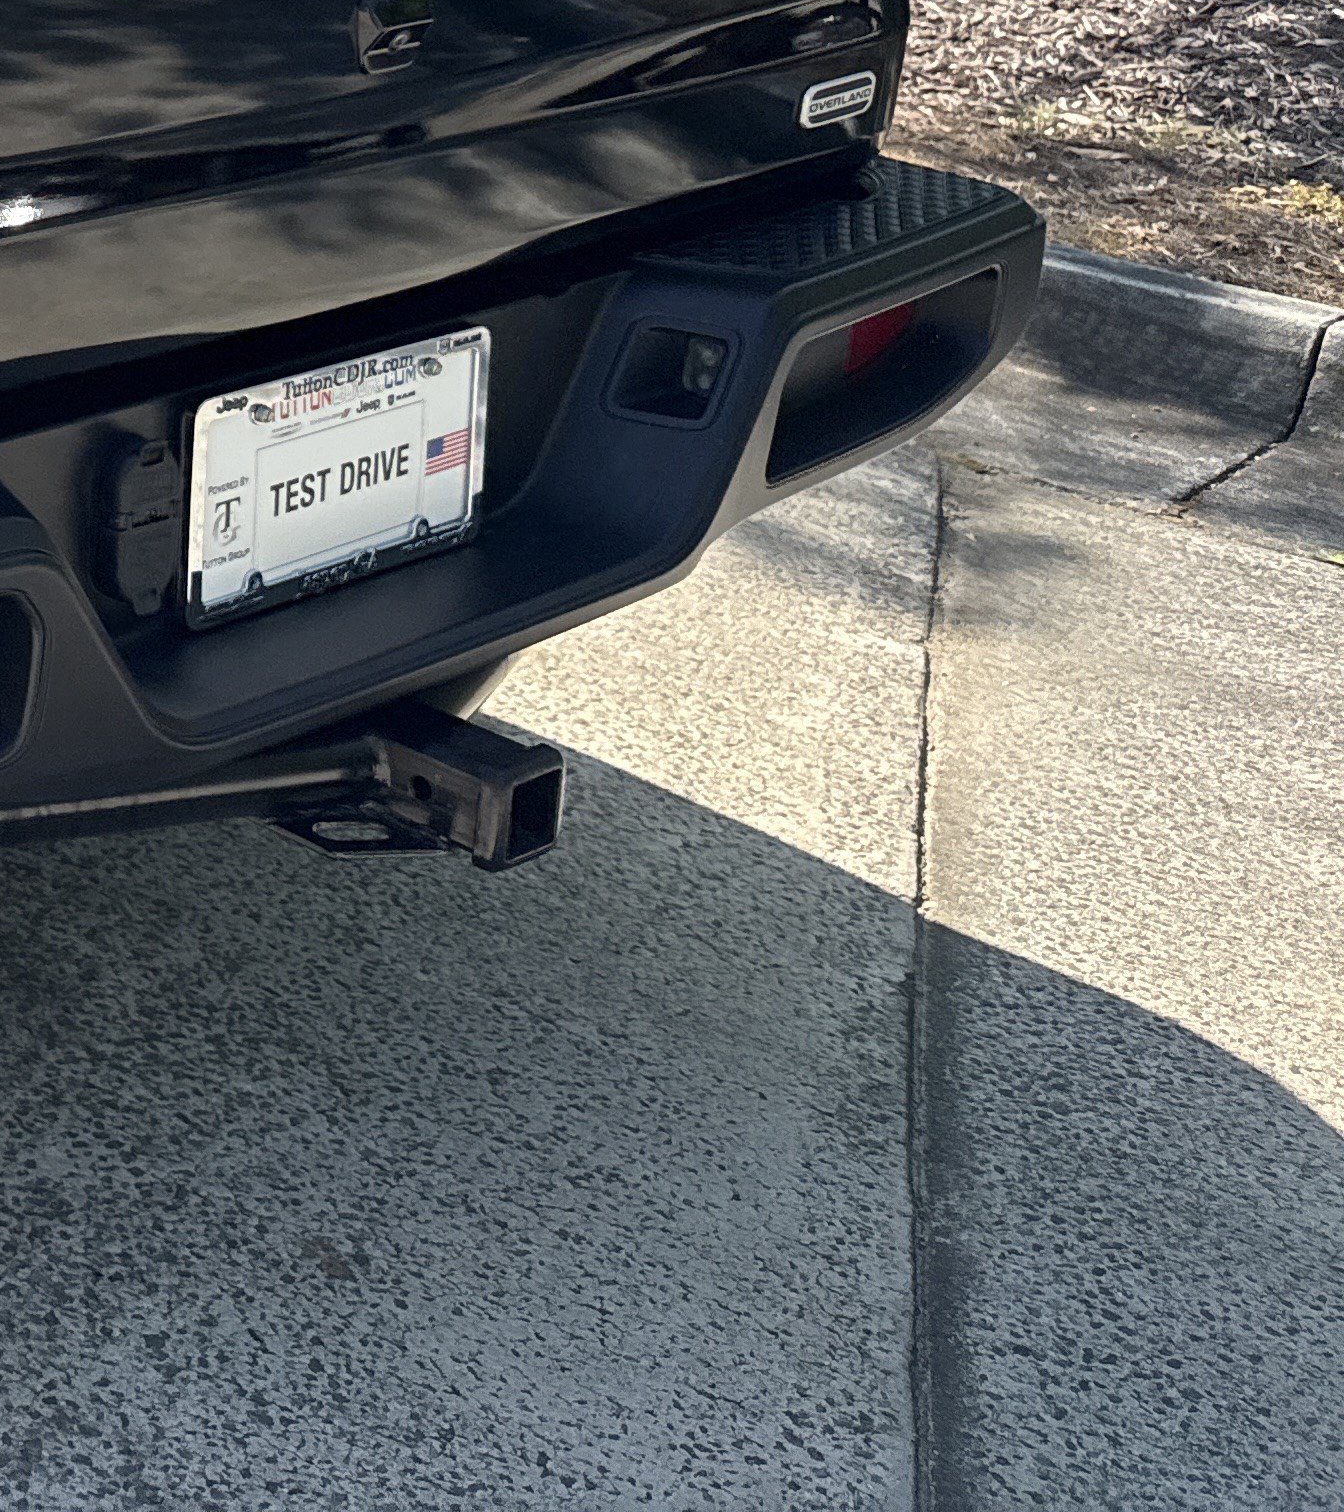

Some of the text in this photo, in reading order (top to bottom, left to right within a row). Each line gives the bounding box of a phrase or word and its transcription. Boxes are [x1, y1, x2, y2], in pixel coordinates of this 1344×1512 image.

[809, 88, 872, 113] OVERLAND
[281, 353, 414, 402] TuttonCDJR.com
[216, 394, 249, 415] Jeep
[356, 397, 382, 414] Jeep
[270, 444, 411, 518] TEST DRIVE
